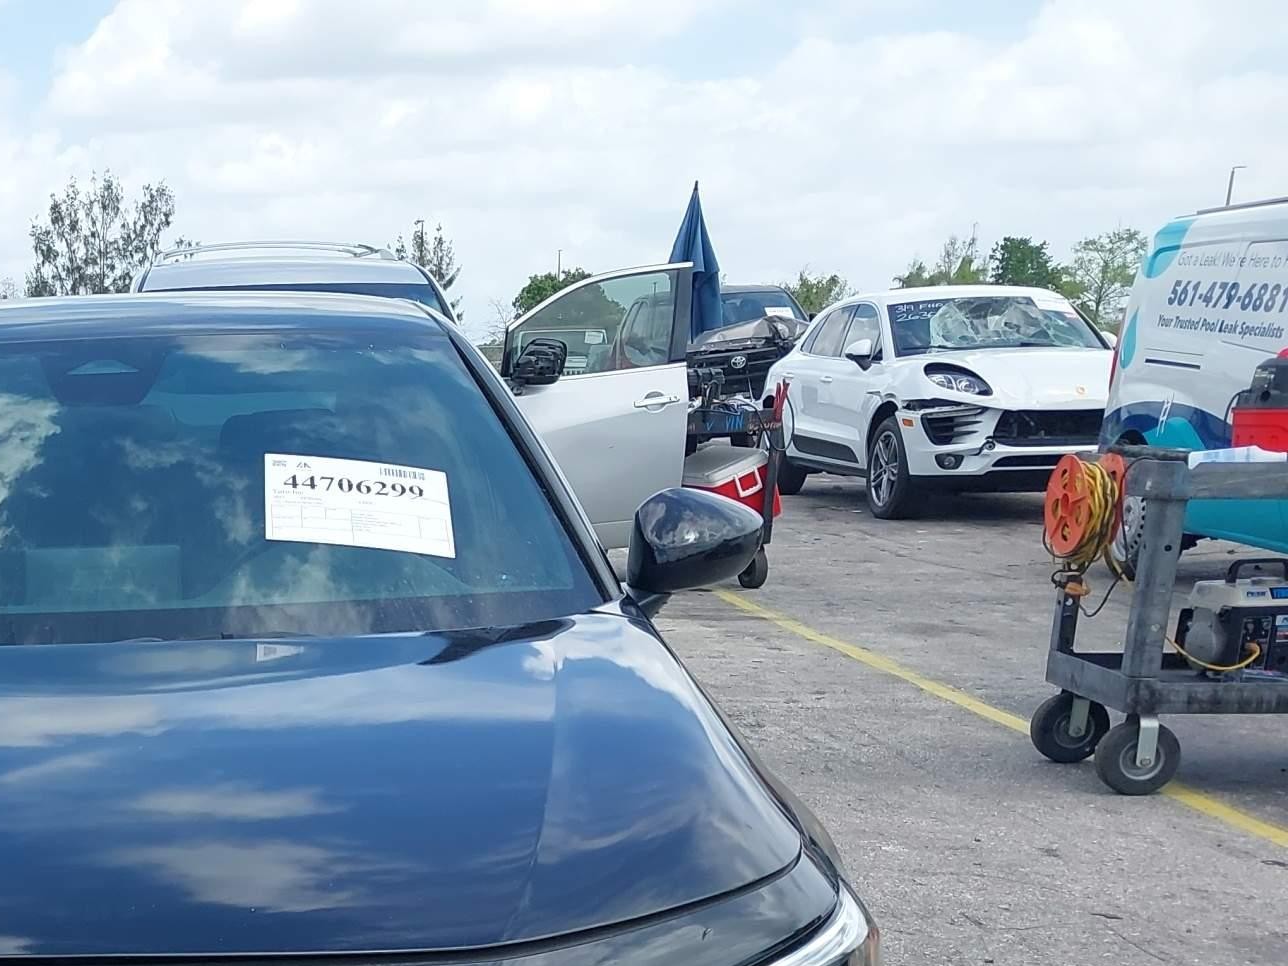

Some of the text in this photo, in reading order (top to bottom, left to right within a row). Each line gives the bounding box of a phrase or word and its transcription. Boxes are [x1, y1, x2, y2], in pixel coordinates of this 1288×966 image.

[1167, 280, 1288, 313] 561-479-6881
[1158, 314, 1285, 340] Your Trusted Pool Leak Specialists
[283, 473, 424, 499] 44706299
